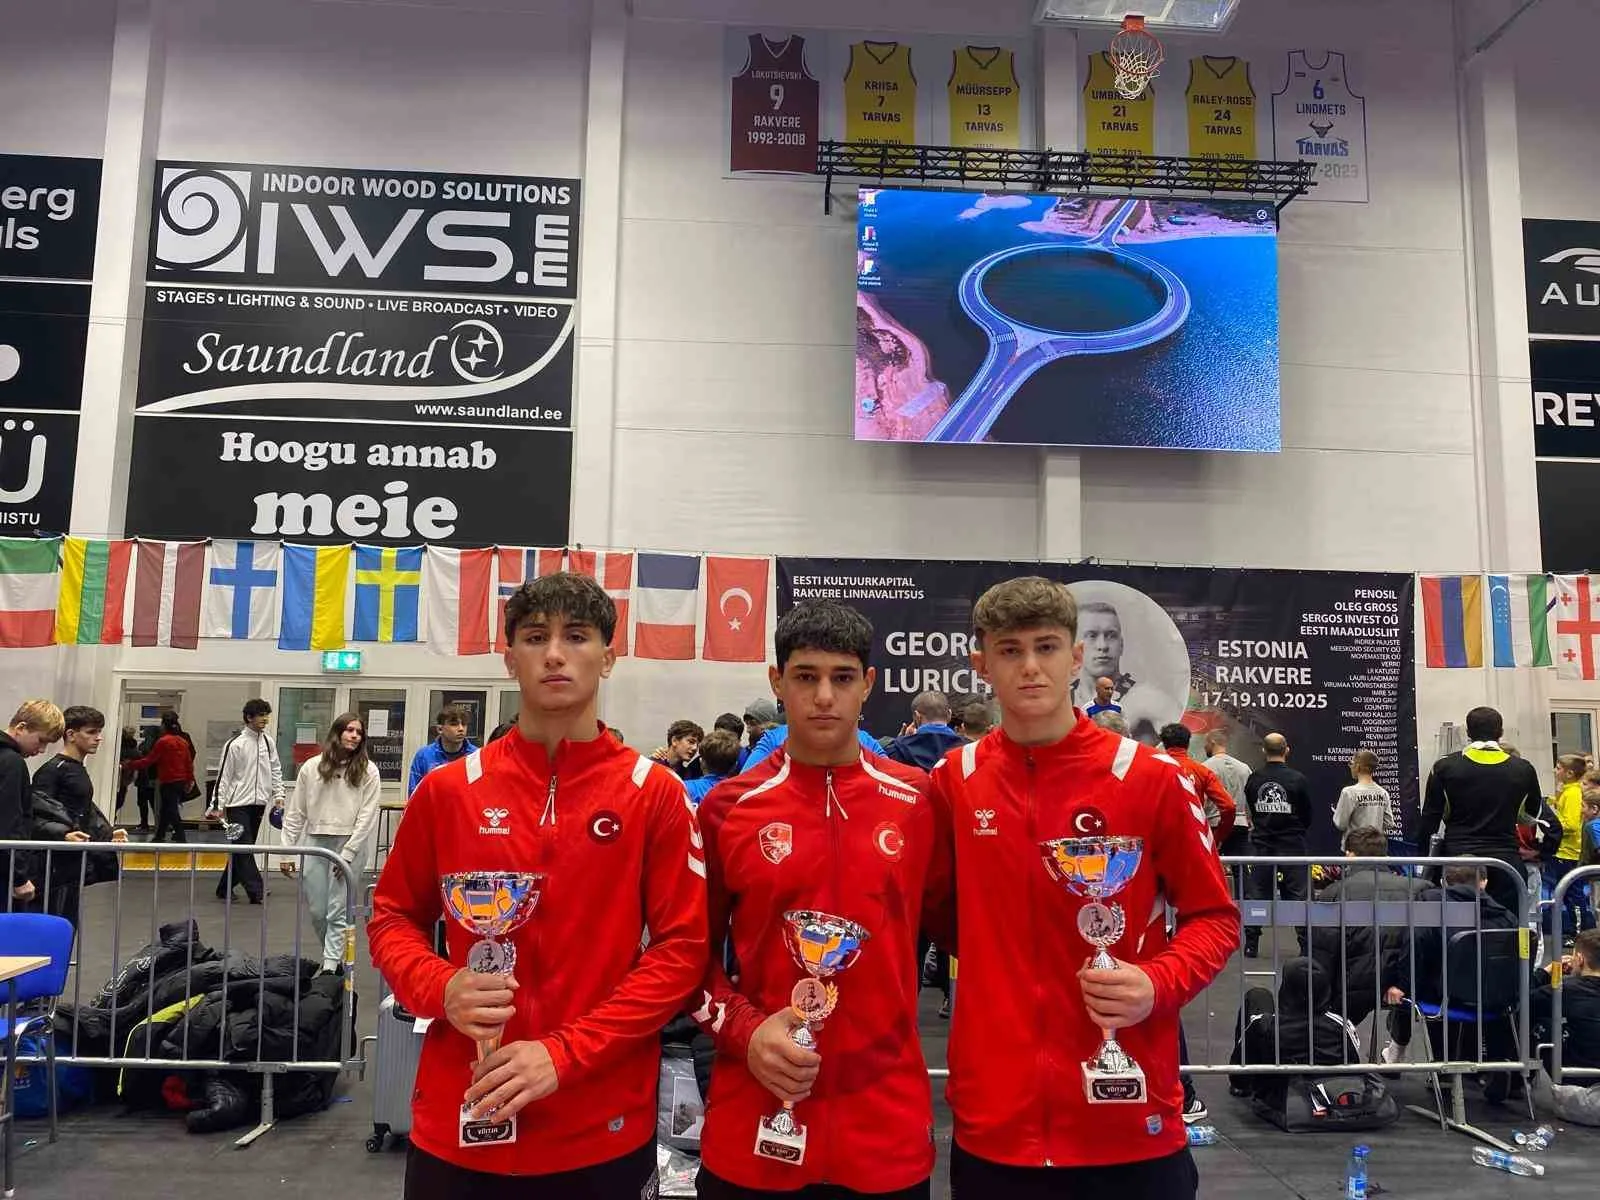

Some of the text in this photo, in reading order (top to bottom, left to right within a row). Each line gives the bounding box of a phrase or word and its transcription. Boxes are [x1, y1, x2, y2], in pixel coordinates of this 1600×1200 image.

[864, 80, 899, 92] KRIISA
[956, 84, 1012, 96] MÜÜRSEPP
[1313, 79, 1324, 99] 6
[770, 84, 784, 110] 9
[877, 96, 886, 107] 7
[1193, 94, 1252, 105] RALEY-ROSS
[977, 104, 991, 116] 13
[1112, 105, 1126, 117] 21
[1296, 103, 1346, 115] LINDMETS
[754, 115, 801, 128] RAKVERE
[862, 111, 901, 123] TARVAS
[1214, 110, 1231, 121] 24
[965, 121, 1004, 132] TARVAS
[1101, 121, 1139, 132] TARVAS
[1205, 125, 1242, 136] TARVAS
[747, 131, 806, 146] 1992-2008
[1296, 138, 1348, 156] TARVAS
[262, 173, 571, 205] INDOOR WOOD SOLUTIONS
[1, 186, 75, 221] erg
[0, 217, 40, 250] ls
[156, 290, 558, 318] STAGES LIGHTING & SOUND LIVE BROADCAST VIDEO
[183, 331, 449, 379] Saundland
[415, 404, 563, 420] www.saundland.ee
[220, 431, 497, 471] Hoogu annab
[250, 480, 458, 539] meie
[0, 511, 41, 525] ISTU
[793, 576, 916, 587] EESTI KULTUURKAPITAL
[793, 588, 925, 599] RAKVERE LINNAVALITSUS
[1354, 589, 1398, 599] PENOSIL
[1334, 602, 1398, 612] OLEG GROSS
[1302, 613, 1399, 625] SERGOS INVEST OÜ
[1300, 626, 1400, 637] EESTI MAADLUSLIIT
[1218, 639, 1309, 659] ESTONIA
[1215, 666, 1312, 685] RAKVERE
[1201, 691, 1328, 709] 17-19.10.2025
[879, 783, 917, 805] hummel
[479, 825, 510, 835] hummel
[973, 826, 998, 836] hummel
